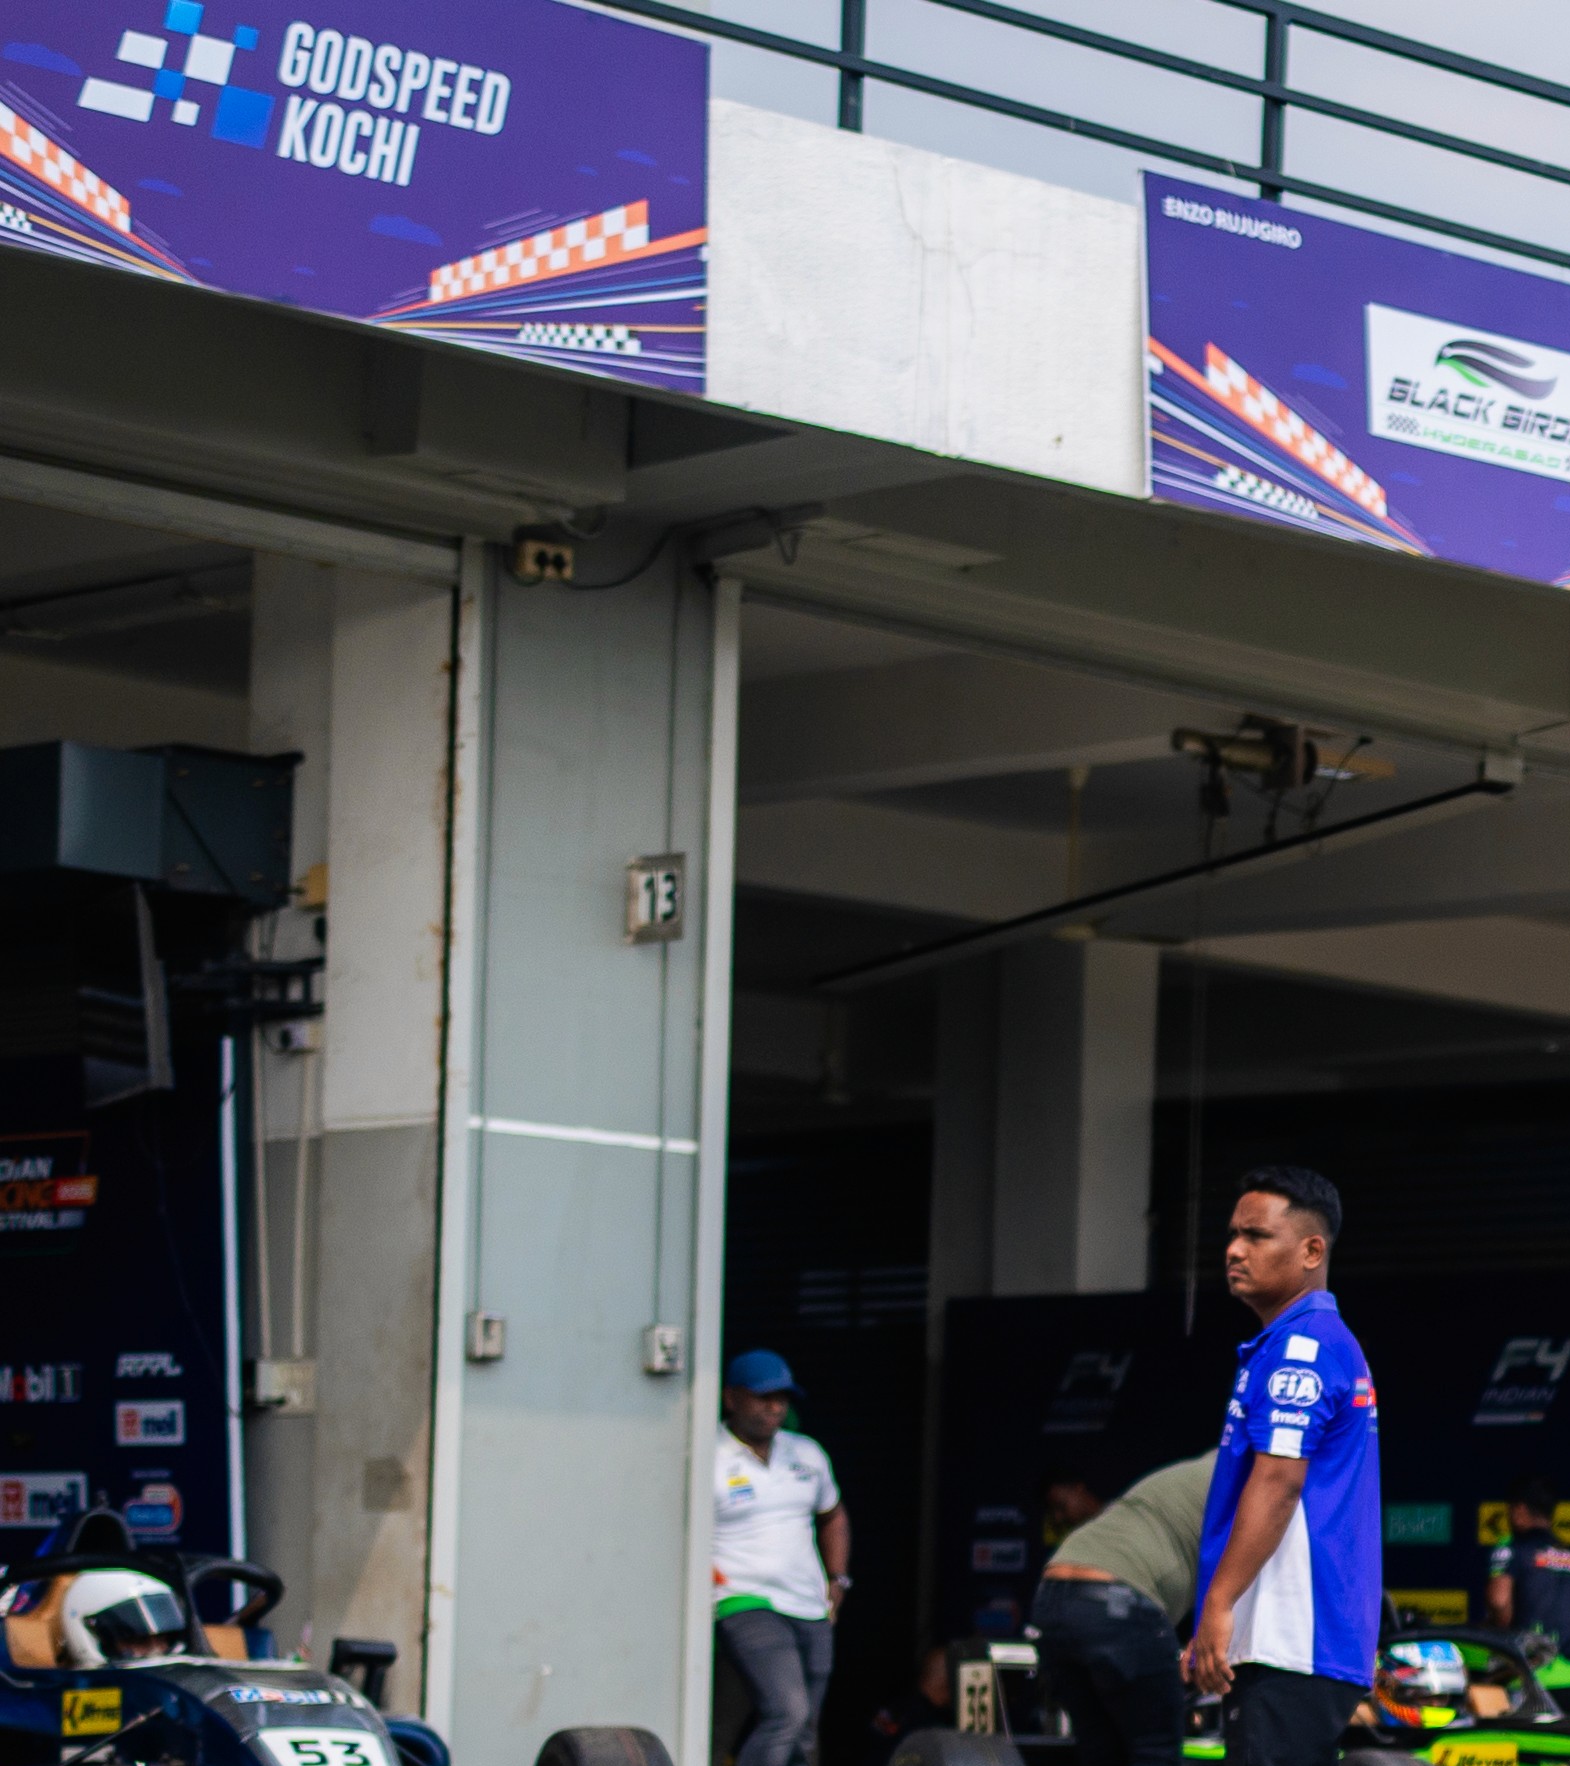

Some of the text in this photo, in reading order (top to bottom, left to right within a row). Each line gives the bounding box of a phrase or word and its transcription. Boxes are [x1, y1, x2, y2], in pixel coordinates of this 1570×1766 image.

[277, 20, 512, 136] GODSPEED
[277, 96, 420, 187] KOCHI
[1162, 196, 1302, 249] ENZO RUJUGIRO
[1388, 376, 1495, 425] BLACK
[1423, 426, 1561, 469] HYDERABAD
[644, 872, 677, 923] 13
